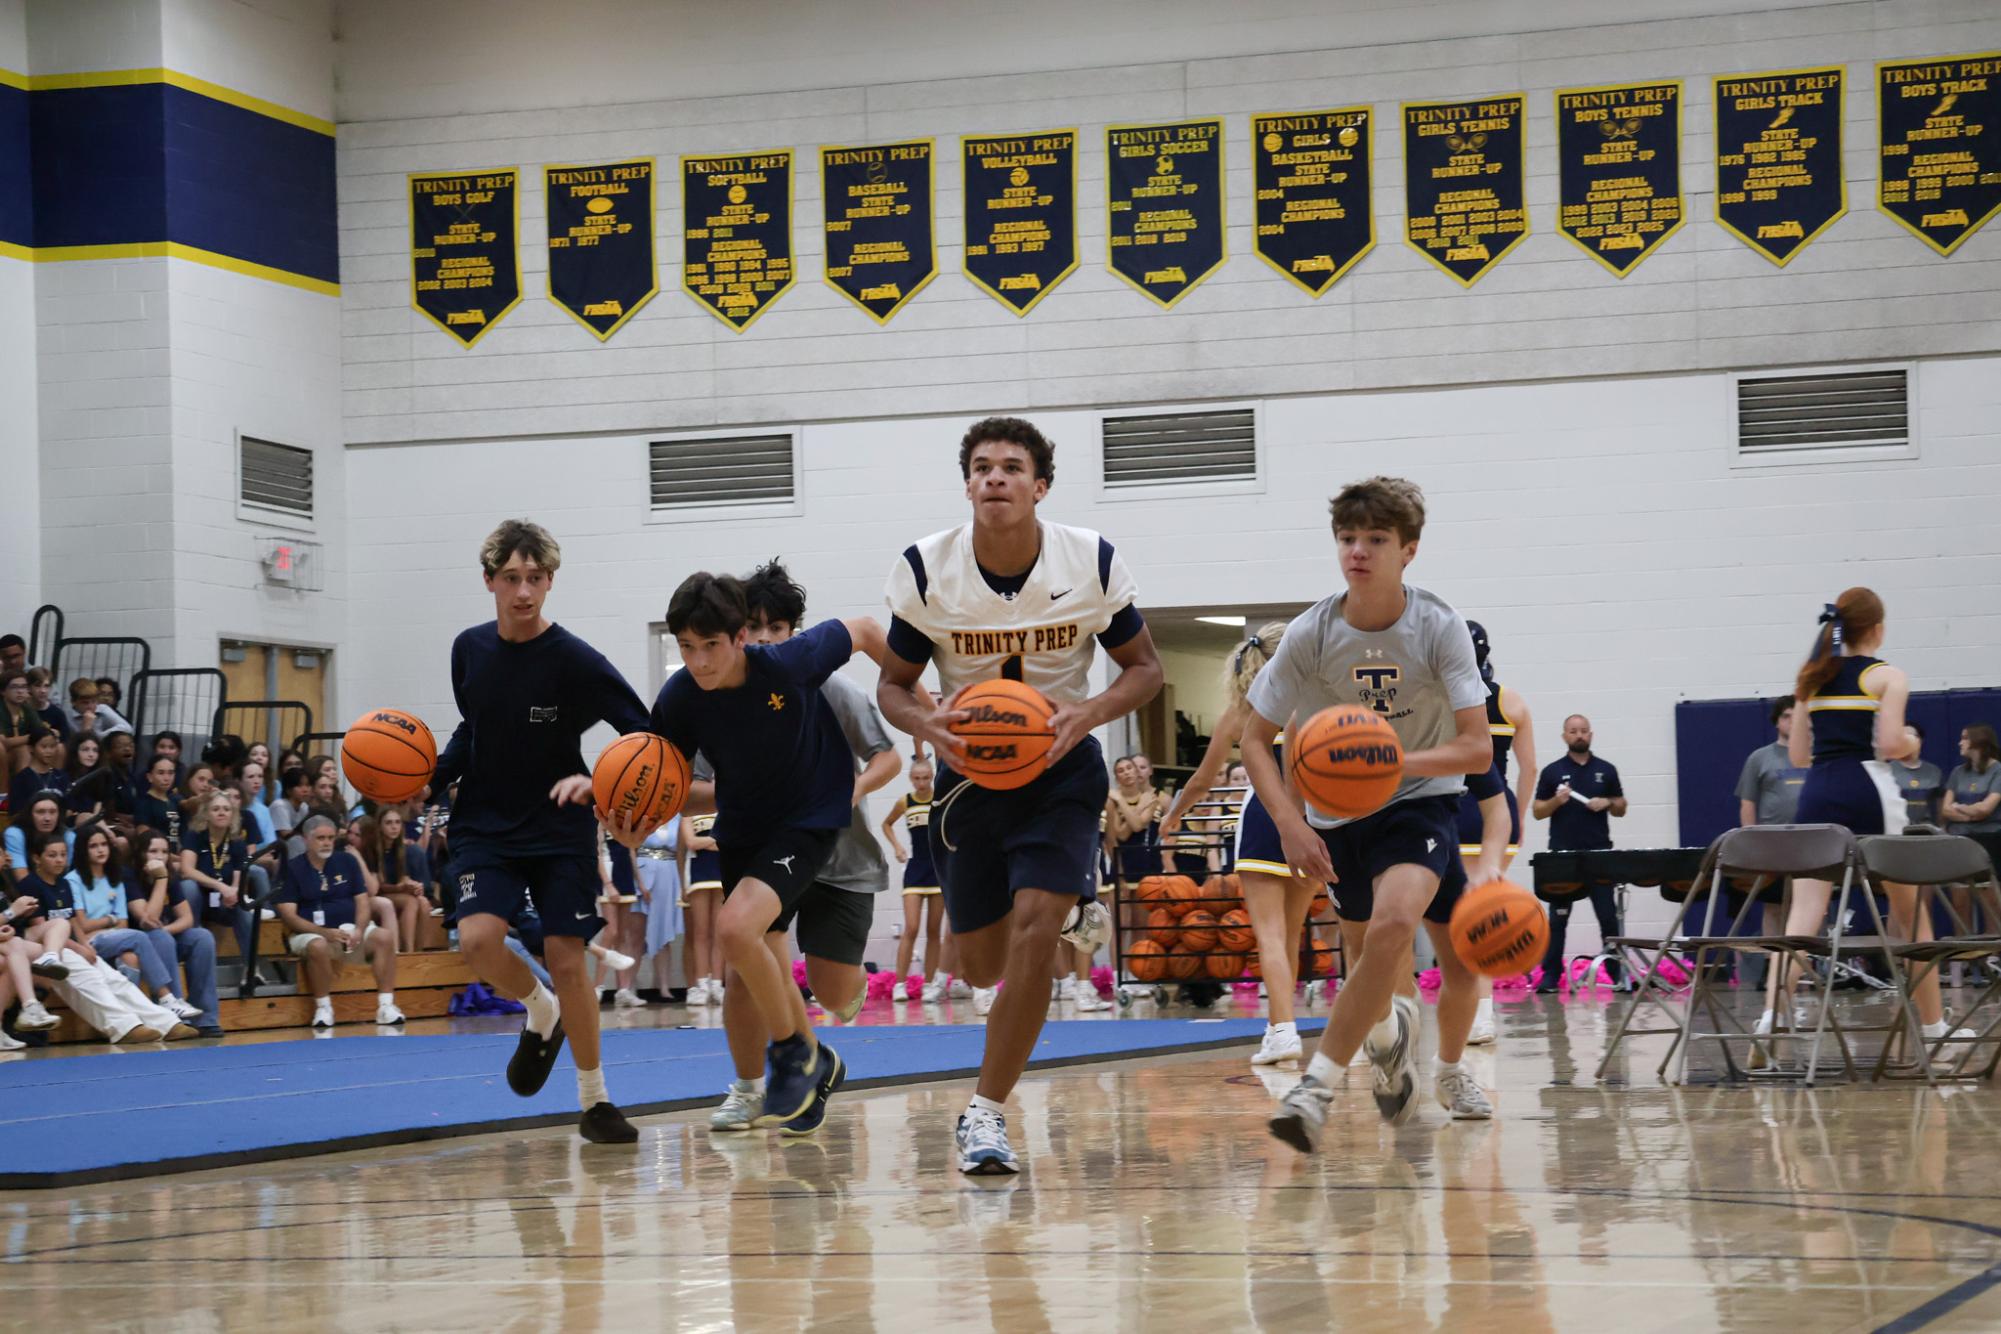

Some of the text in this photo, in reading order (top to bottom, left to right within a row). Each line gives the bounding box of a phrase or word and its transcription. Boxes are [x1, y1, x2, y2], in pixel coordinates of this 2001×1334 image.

[1884, 65, 1955, 83] TRINITY
[1720, 75, 1839, 97] TRINITY PREP
[1901, 78, 1987, 98] BOYS TRACK
[1562, 87, 1676, 109] TRINITY PREP
[1735, 92, 1823, 111] GIRLS TRACK
[1408, 103, 1520, 123] TRINITY PREP
[1575, 104, 1663, 123] BOYS TENNIS
[1257, 113, 1366, 133] TRINITY PREP
[1418, 118, 1510, 137] GIRLS TENNIS
[1111, 126, 1217, 145] TRINITY PREP
[1293, 133, 1331, 147] GIRLS
[1761, 128, 1799, 141] STATE
[967, 137, 1072, 156] TRINITY PREP
[1119, 140, 1209, 158] GIRLS SOCCER
[1601, 141, 1638, 153] STATE
[687, 156, 788, 173] TRINITY PREP
[826, 147, 928, 165] TRINITY PREP
[982, 153, 1057, 168] VOLLEYBALL
[1272, 150, 1353, 166] BASKETBALL
[415, 176, 514, 193] TRINITY PREP
[550, 167, 649, 184] TRINITY PREP
[708, 172, 767, 186] SOFTBALL
[570, 183, 629, 197] FOOTBALL
[848, 182, 908, 196] BASEBALL
[433, 192, 495, 206] BOYS GOLF
[951, 623, 1078, 656] TRINITY PREP
[1351, 664, 1401, 714] T
[369, 712, 417, 736] NCAA
[966, 743, 1018, 761] NCAA
